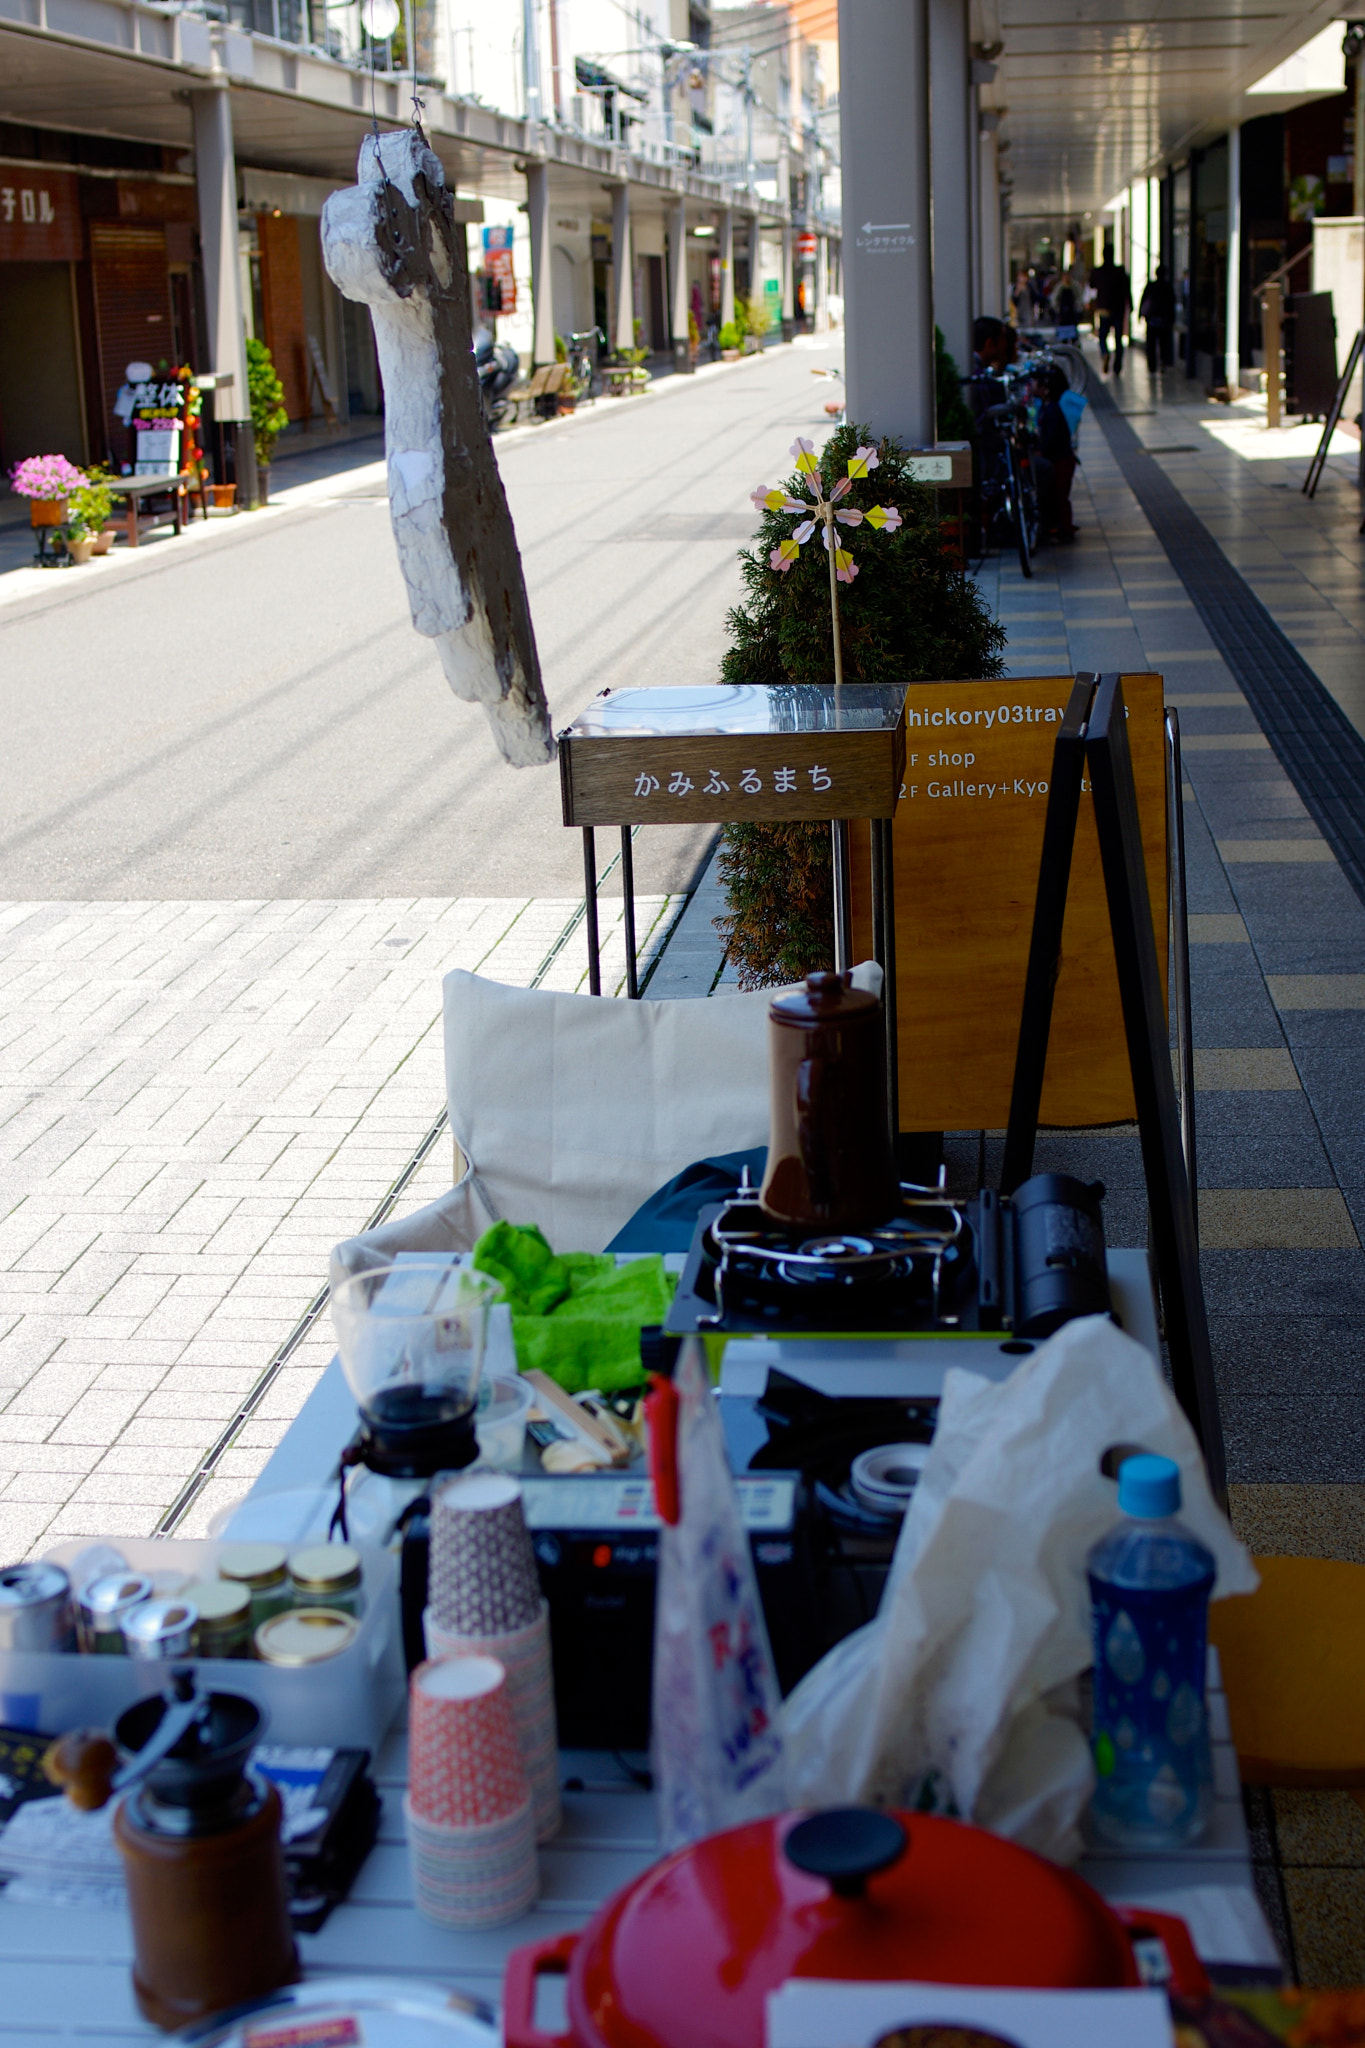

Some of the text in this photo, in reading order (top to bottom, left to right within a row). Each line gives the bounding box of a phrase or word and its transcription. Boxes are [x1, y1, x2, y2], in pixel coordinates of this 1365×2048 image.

[855, 236, 915, 247] レンタサイクル
[135, 382, 185, 408] 整体
[928, 750, 976, 768] shop
[634, 765, 832, 797] かみふるまち
